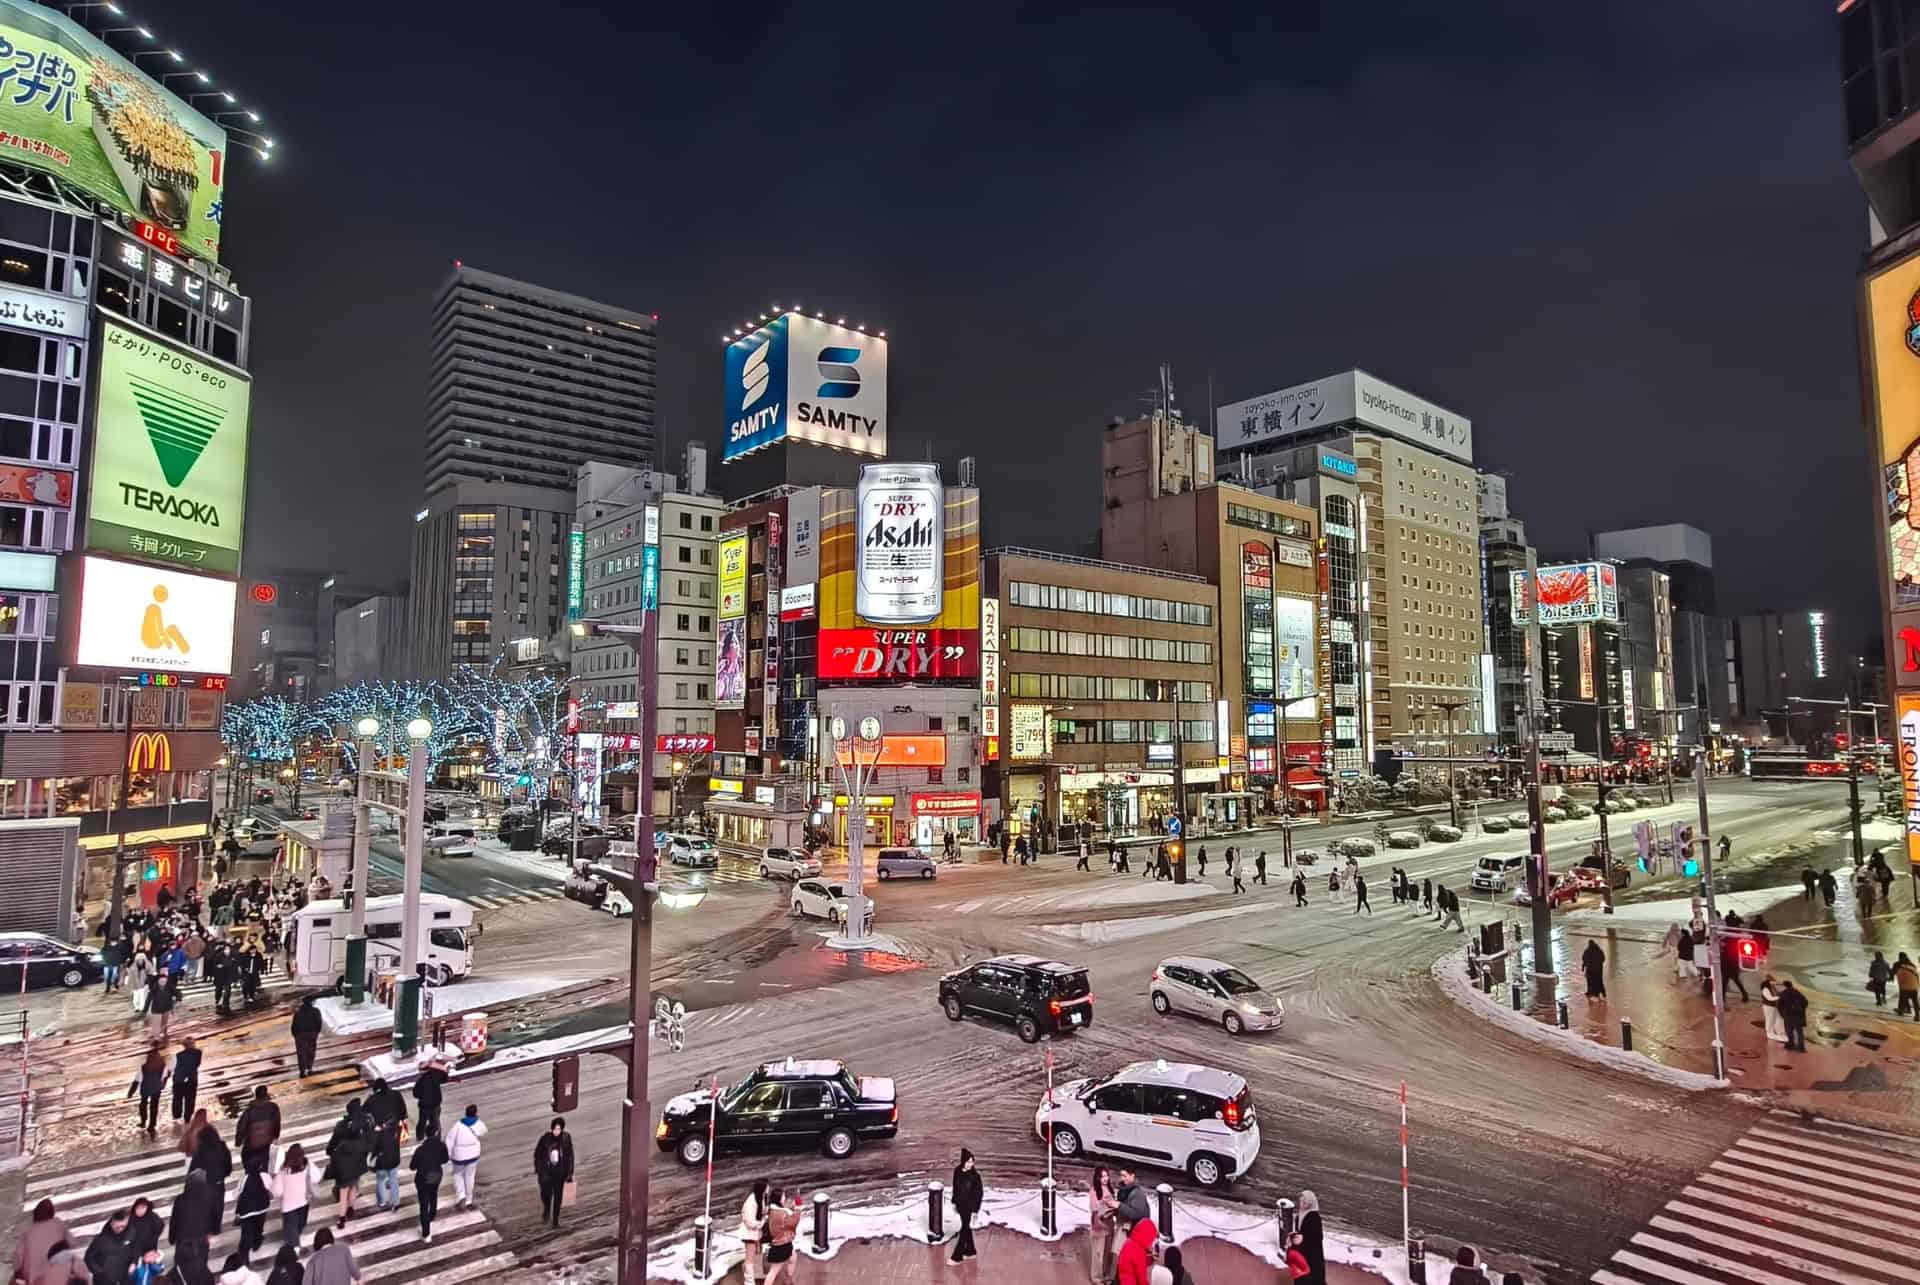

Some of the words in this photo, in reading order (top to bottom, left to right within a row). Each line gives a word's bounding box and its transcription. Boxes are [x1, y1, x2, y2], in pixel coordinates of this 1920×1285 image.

[730, 402, 781, 442] SAMTY
[797, 402, 878, 437] SAMTY
[1240, 400, 1326, 439] 東横イン
[1421, 410, 1467, 445] 東横イン
[119, 481, 220, 527] TERAOKA
[866, 518, 933, 548] Asahi
[890, 553, 908, 566] 生
[872, 631, 927, 645] SUPER
[140, 672, 179, 687] SABRO
